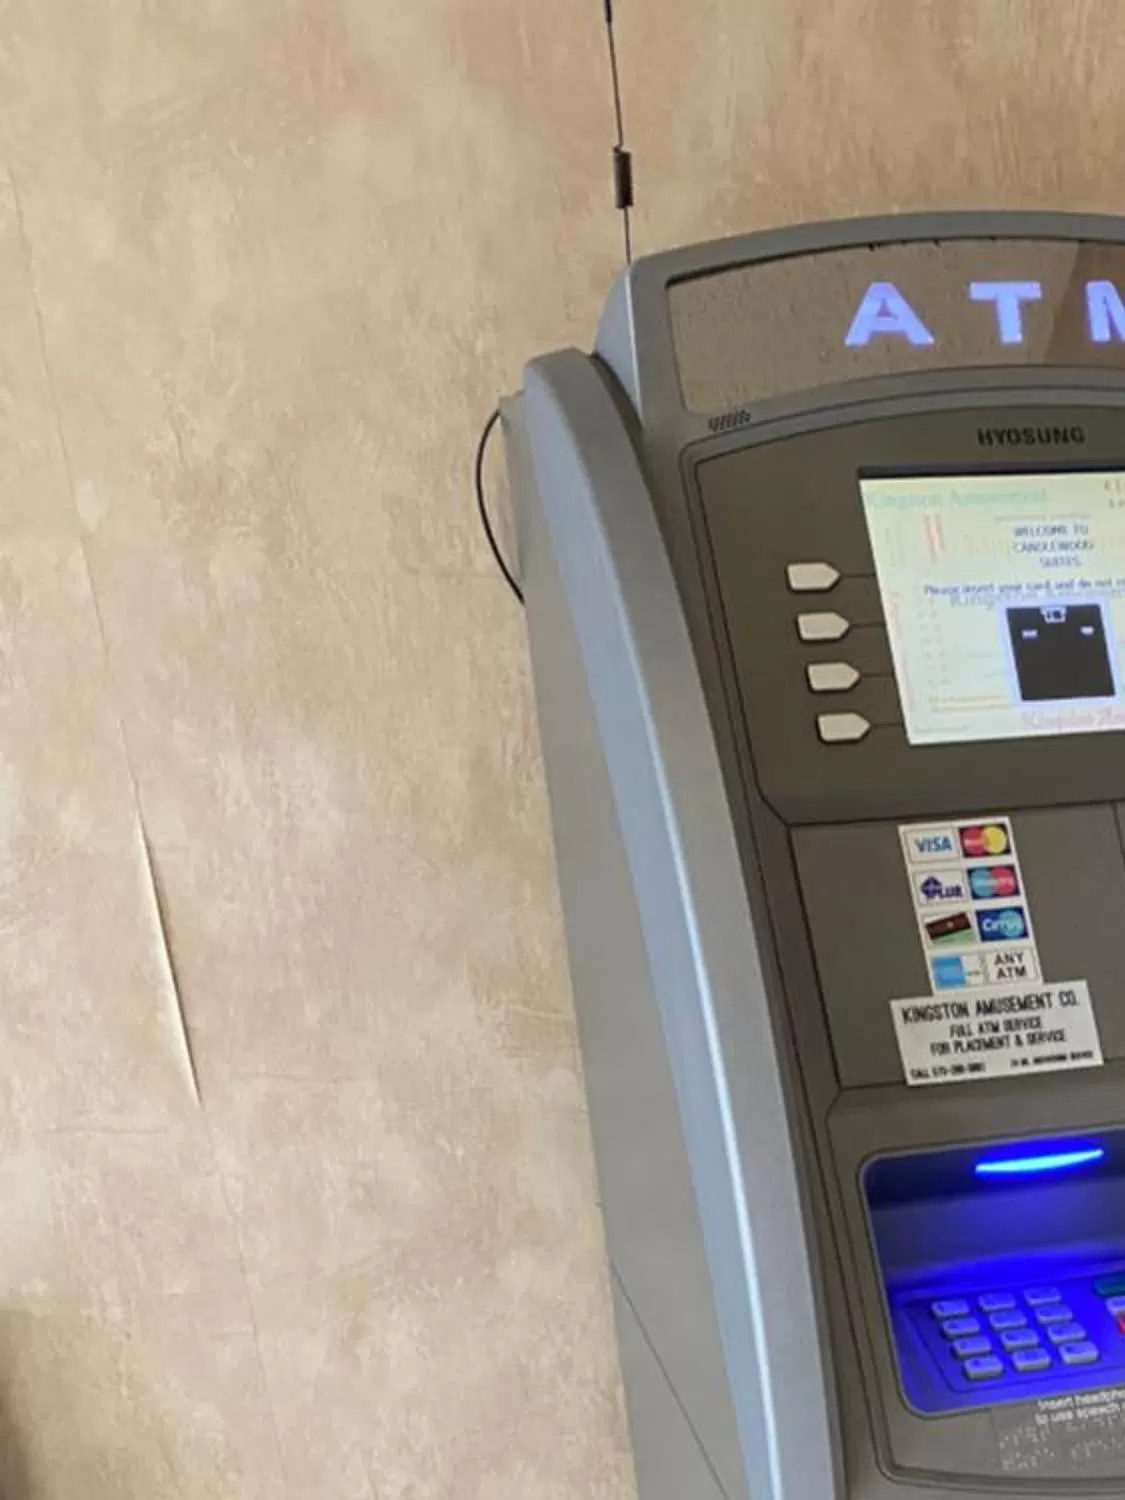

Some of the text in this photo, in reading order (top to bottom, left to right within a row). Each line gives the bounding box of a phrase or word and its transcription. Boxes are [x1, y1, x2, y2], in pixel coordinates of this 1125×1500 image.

[976, 425, 1086, 447] HYOSUNG
[915, 836, 952, 853] VISA
[994, 952, 1024, 966] ANY
[996, 965, 1027, 979] ATM
[901, 1003, 970, 1025] KINGSTON
[974, 991, 1053, 1015] AMUSEMENT
[949, 1015, 1042, 1038] FULL ATM SERVICE
[930, 1040, 951, 1055] FOR
[1026, 1028, 1066, 1046] SERVICE
[1035, 1412, 1049, 1425] to
[1050, 1410, 1074, 1422] use
[1076, 1403, 1120, 1419] speech
